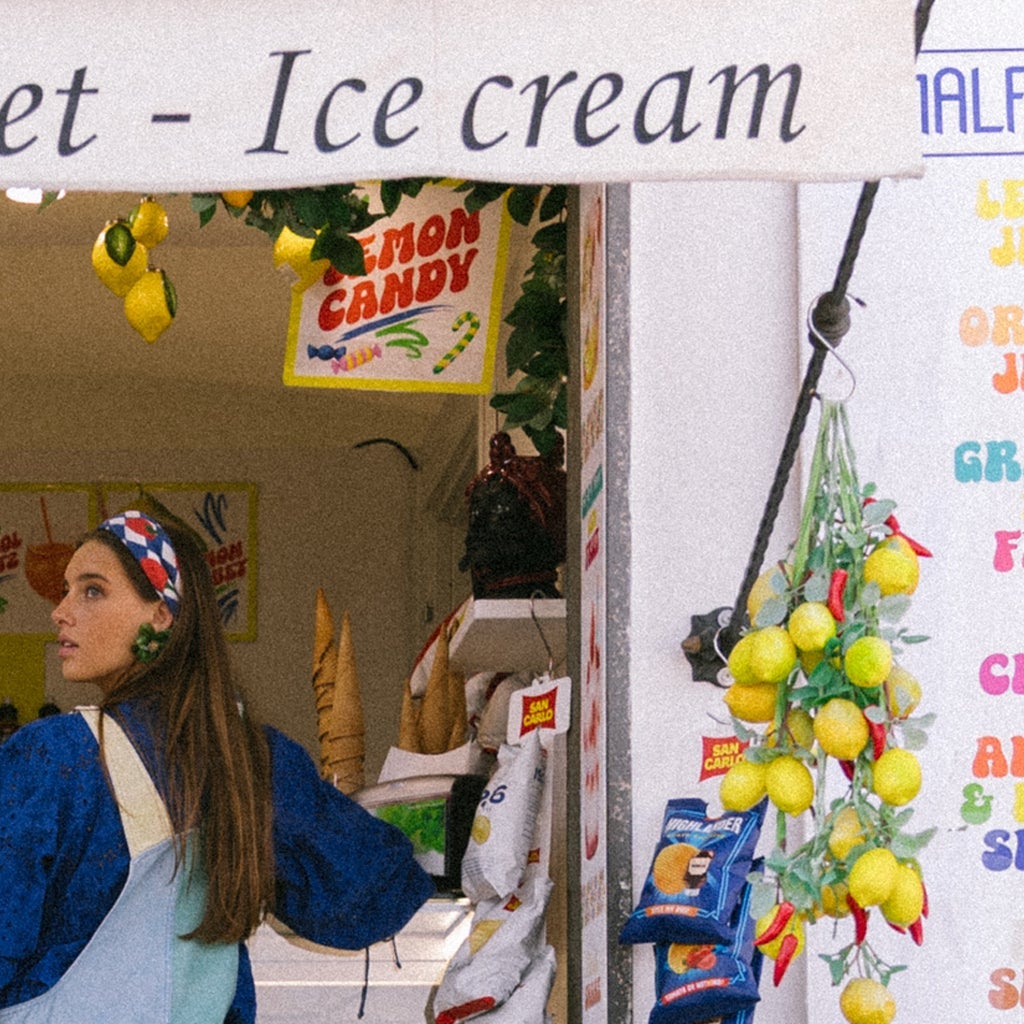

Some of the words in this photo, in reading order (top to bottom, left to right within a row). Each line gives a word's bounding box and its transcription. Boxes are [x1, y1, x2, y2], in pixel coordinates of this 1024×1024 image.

[244, 49, 424, 155] Ice
[460, 58, 807, 152] cream
[323, 208, 480, 286] EMON
[318, 248, 479, 331] CANDY
[954, 439, 1024, 483] GR
[523, 708, 553, 728] CARLO
[529, 698, 550, 714] SAN
[712, 742, 739, 757] SAN
